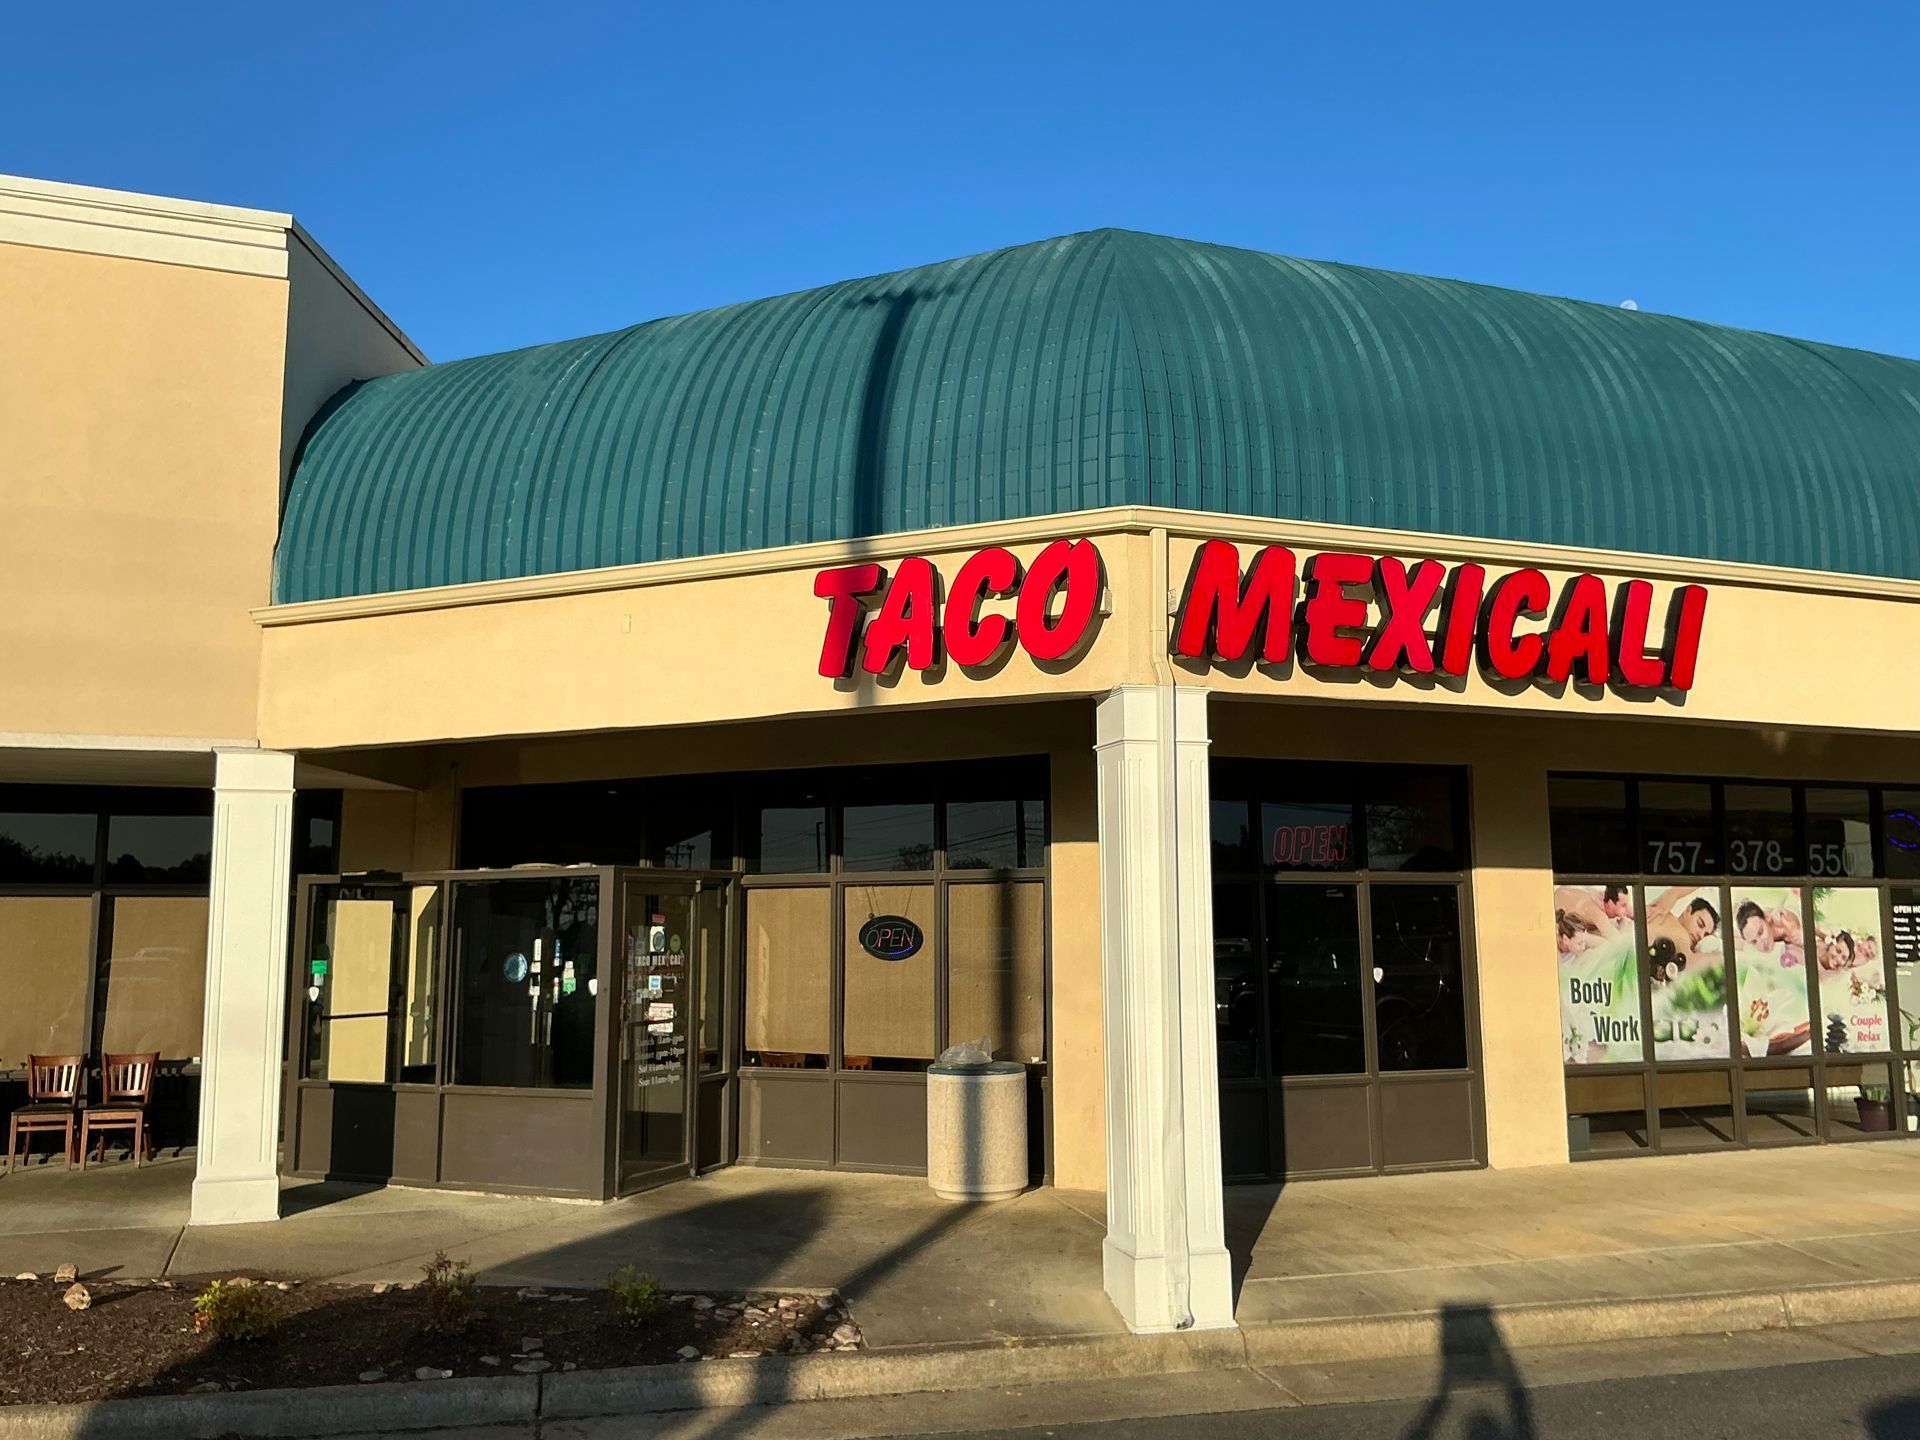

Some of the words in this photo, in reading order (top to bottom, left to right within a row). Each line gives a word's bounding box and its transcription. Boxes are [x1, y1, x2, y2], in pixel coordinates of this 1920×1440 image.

[813, 538, 1102, 679] TACO
[1171, 539, 1709, 692] MEXICALI
[1272, 824, 1347, 863] OPEN
[1648, 841, 1715, 873] 757-
[1730, 840, 1794, 872] 378-
[865, 926, 915, 948] OPEN
[1569, 976, 1612, 1007] Body
[1593, 1015, 1640, 1042] Work
[1850, 1014, 1882, 1028] Couple
[1857, 1031, 1881, 1041] Relax
